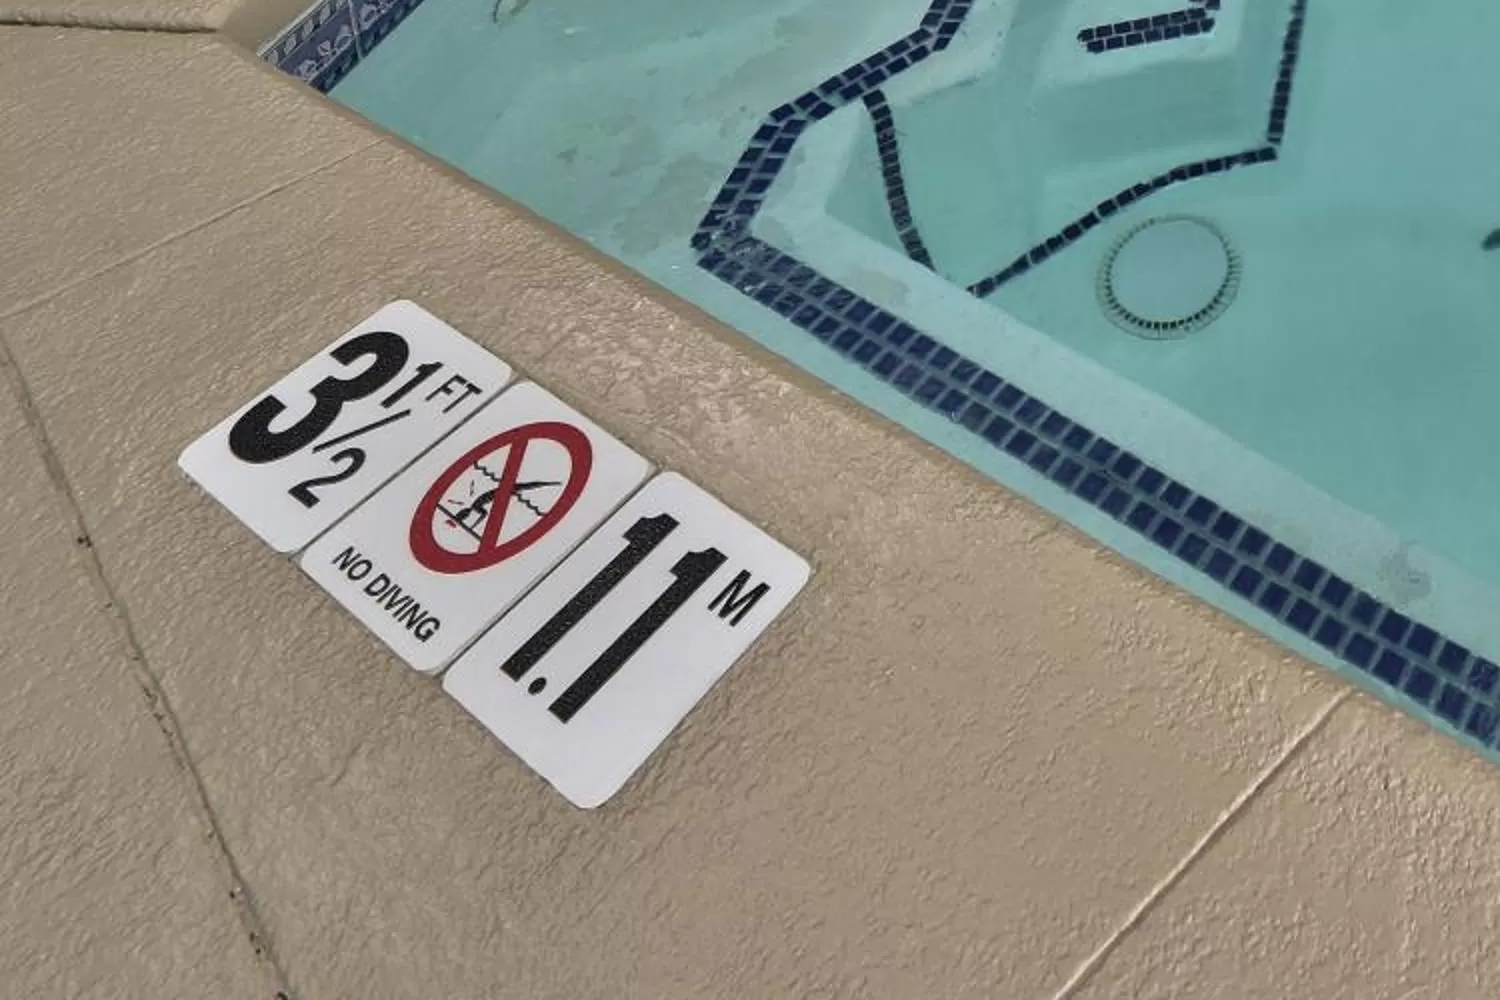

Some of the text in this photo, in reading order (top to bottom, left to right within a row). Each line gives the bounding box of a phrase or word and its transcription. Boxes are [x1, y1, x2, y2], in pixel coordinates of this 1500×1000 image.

[228, 331, 411, 464] 3
[424, 373, 483, 414] FT
[332, 545, 442, 644] NO DIVING
[500, 512, 771, 724] 1.1 M
